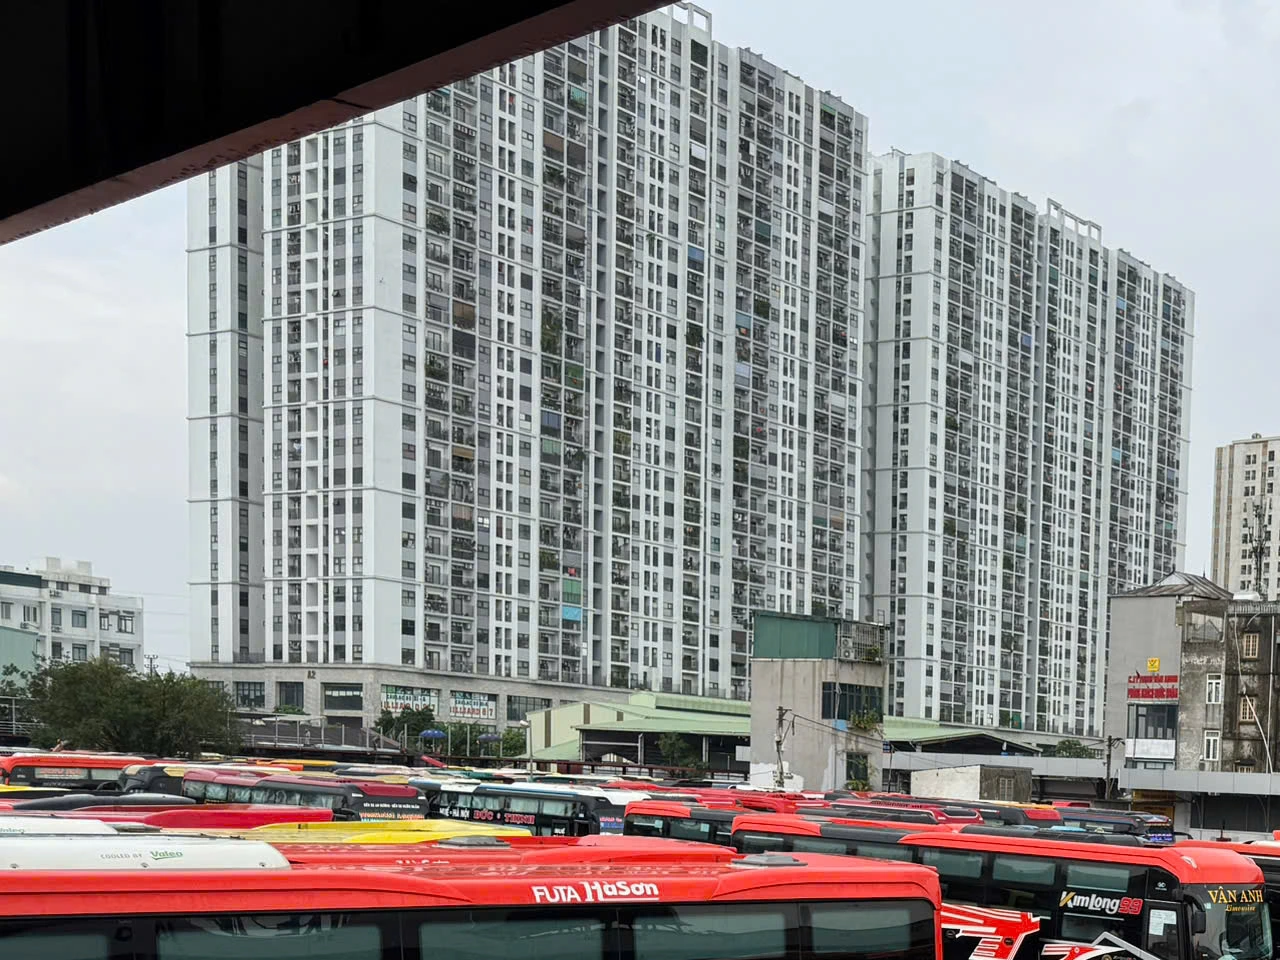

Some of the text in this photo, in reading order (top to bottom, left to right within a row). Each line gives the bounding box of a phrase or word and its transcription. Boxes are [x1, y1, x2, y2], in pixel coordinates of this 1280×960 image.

[150, 851, 183, 859] Valeo
[531, 885, 579, 902] FUTA
[1208, 886, 1263, 904] VÂN ANH
